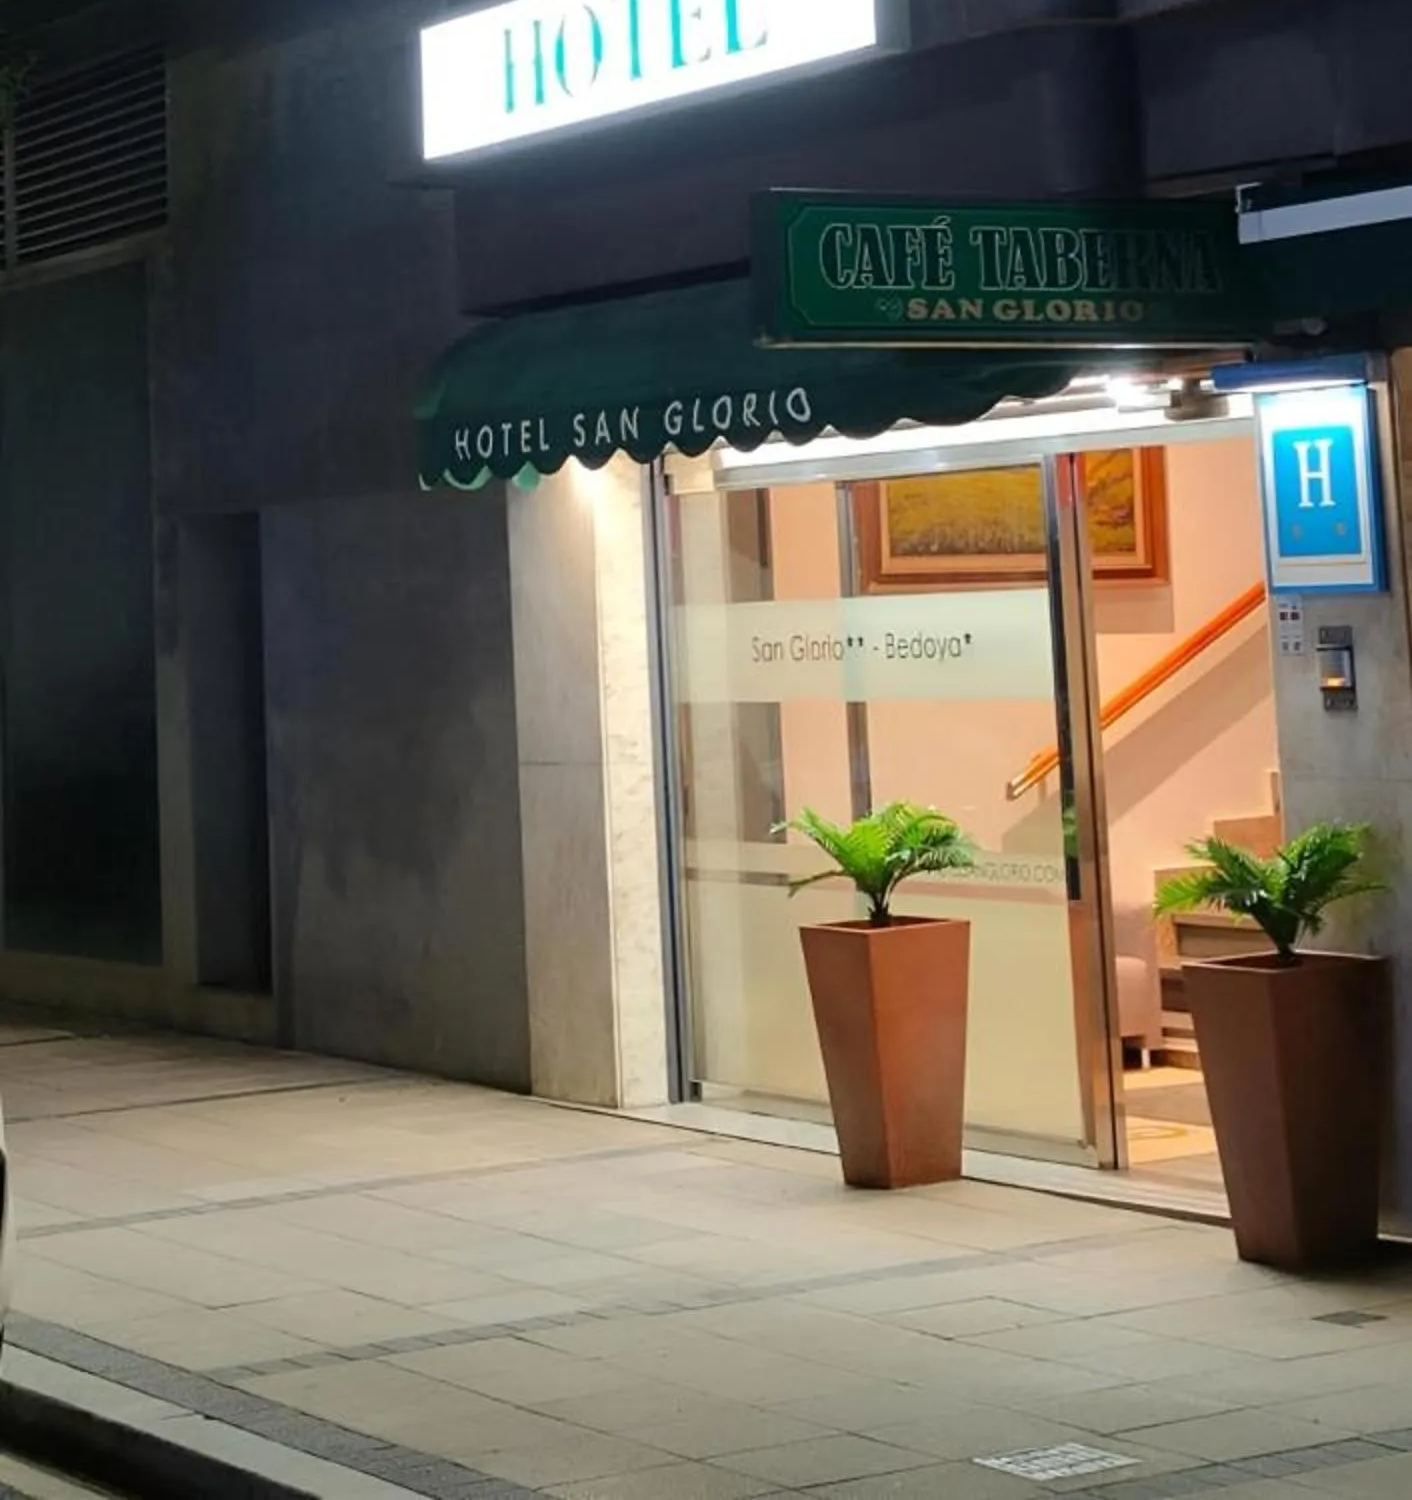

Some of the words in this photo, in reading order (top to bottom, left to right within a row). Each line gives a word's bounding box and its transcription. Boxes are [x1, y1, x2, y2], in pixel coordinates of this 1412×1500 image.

[818, 215, 955, 291] CAFÉ
[969, 226, 1224, 293] TABERNA
[905, 297, 984, 321] SAN
[991, 297, 1145, 323] GLORIO
[455, 417, 550, 461] HOTEL
[572, 405, 640, 447] SAN
[663, 387, 812, 437] GLORIO
[1293, 438, 1337, 508] H
[751, 636, 784, 663] San
